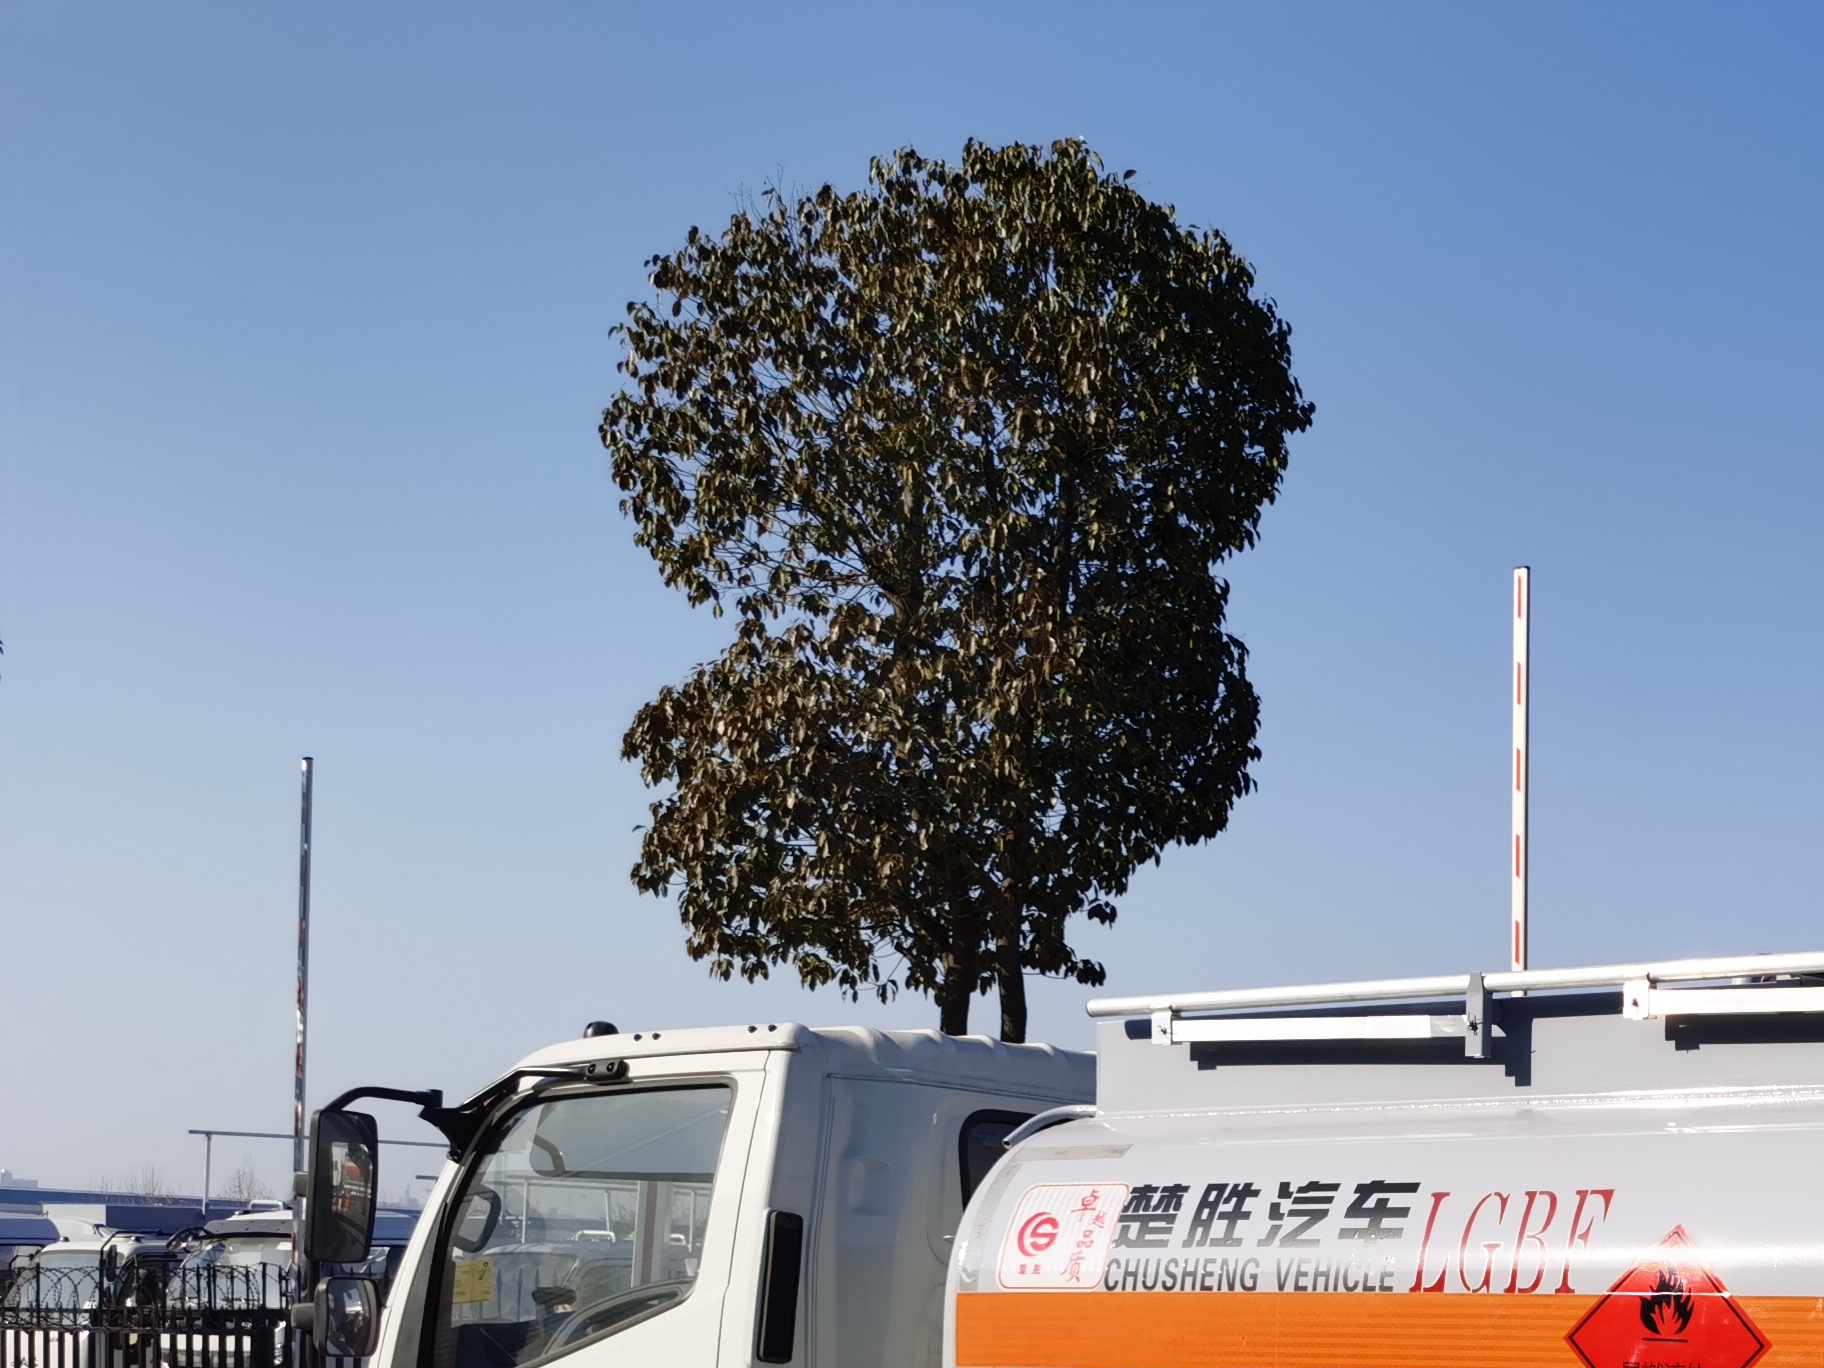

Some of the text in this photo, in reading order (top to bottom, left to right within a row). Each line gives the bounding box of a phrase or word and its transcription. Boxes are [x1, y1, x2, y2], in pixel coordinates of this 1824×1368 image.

[1112, 1180, 1421, 1249] 楚胜汽车
[1408, 1188, 1615, 1294] LGBF
[1104, 1255, 1396, 1294] CHUSHENG VEHICLE
